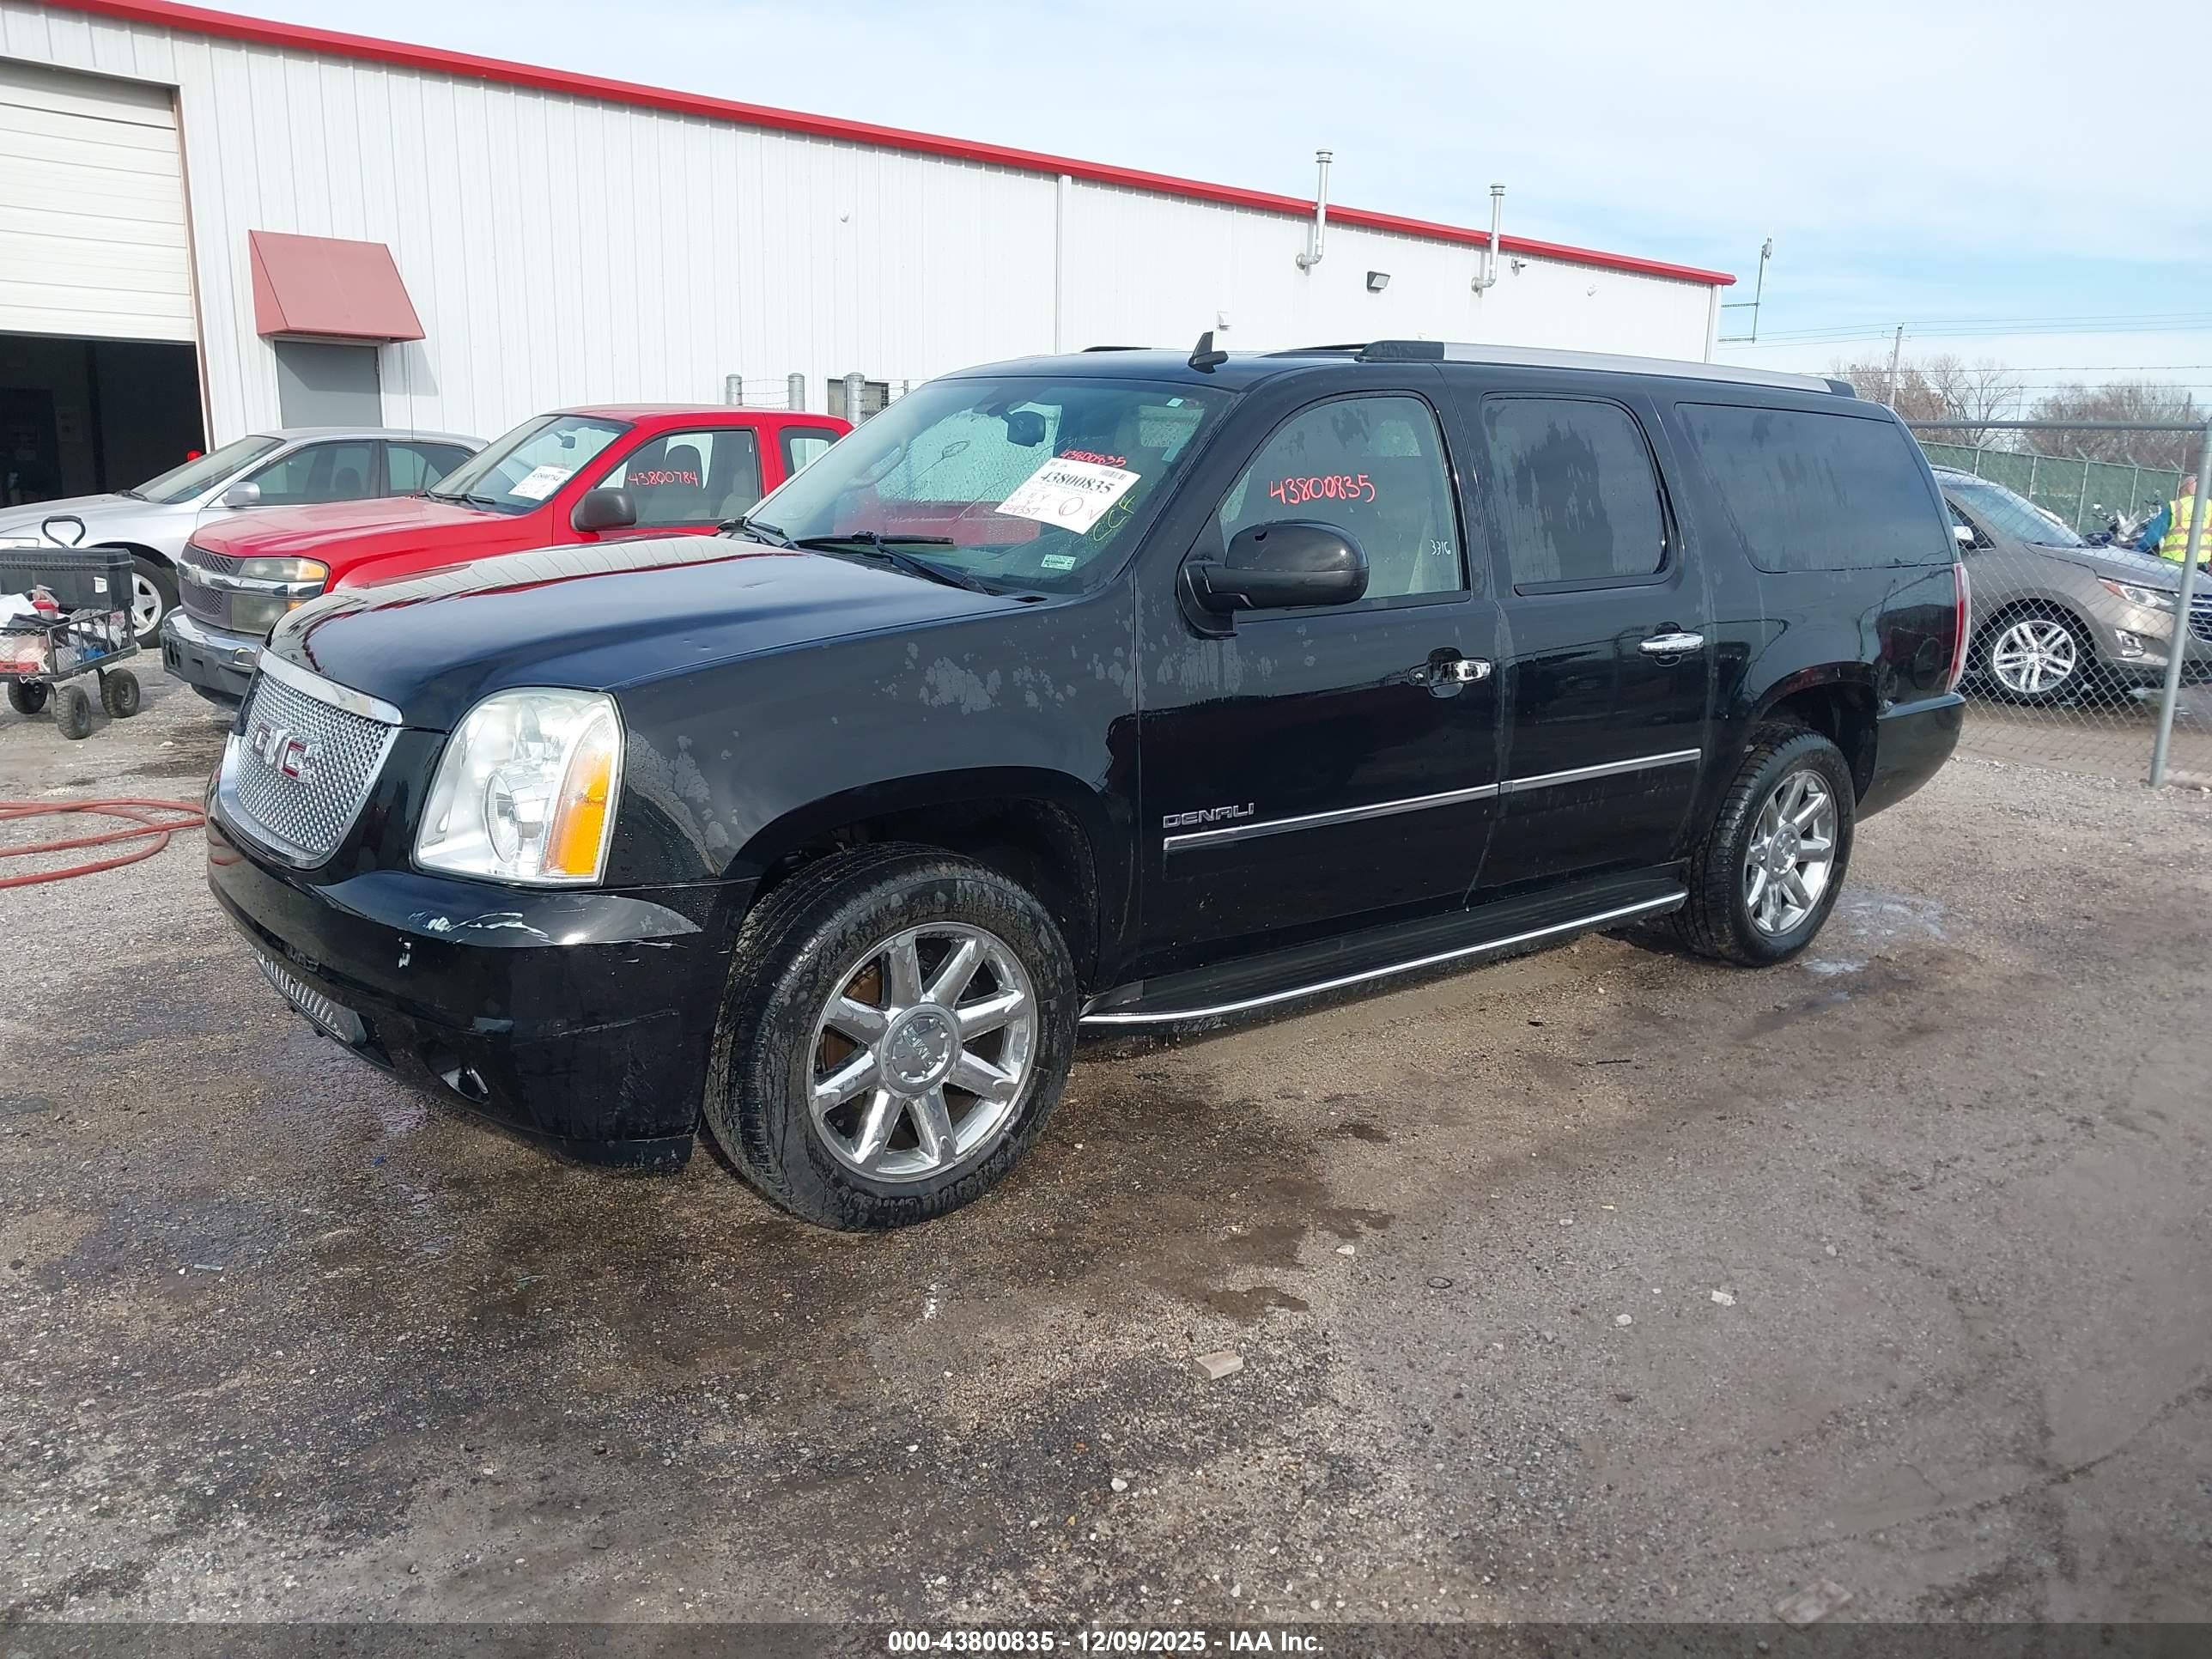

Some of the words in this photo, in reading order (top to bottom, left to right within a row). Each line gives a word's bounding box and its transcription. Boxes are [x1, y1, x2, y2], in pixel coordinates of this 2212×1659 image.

[628, 471, 699, 487] 43800784
[1040, 471, 1115, 494] 43800835
[1270, 473, 1376, 505] 43800835
[253, 719, 316, 784] GMC
[1163, 802, 1255, 829] DENALI
